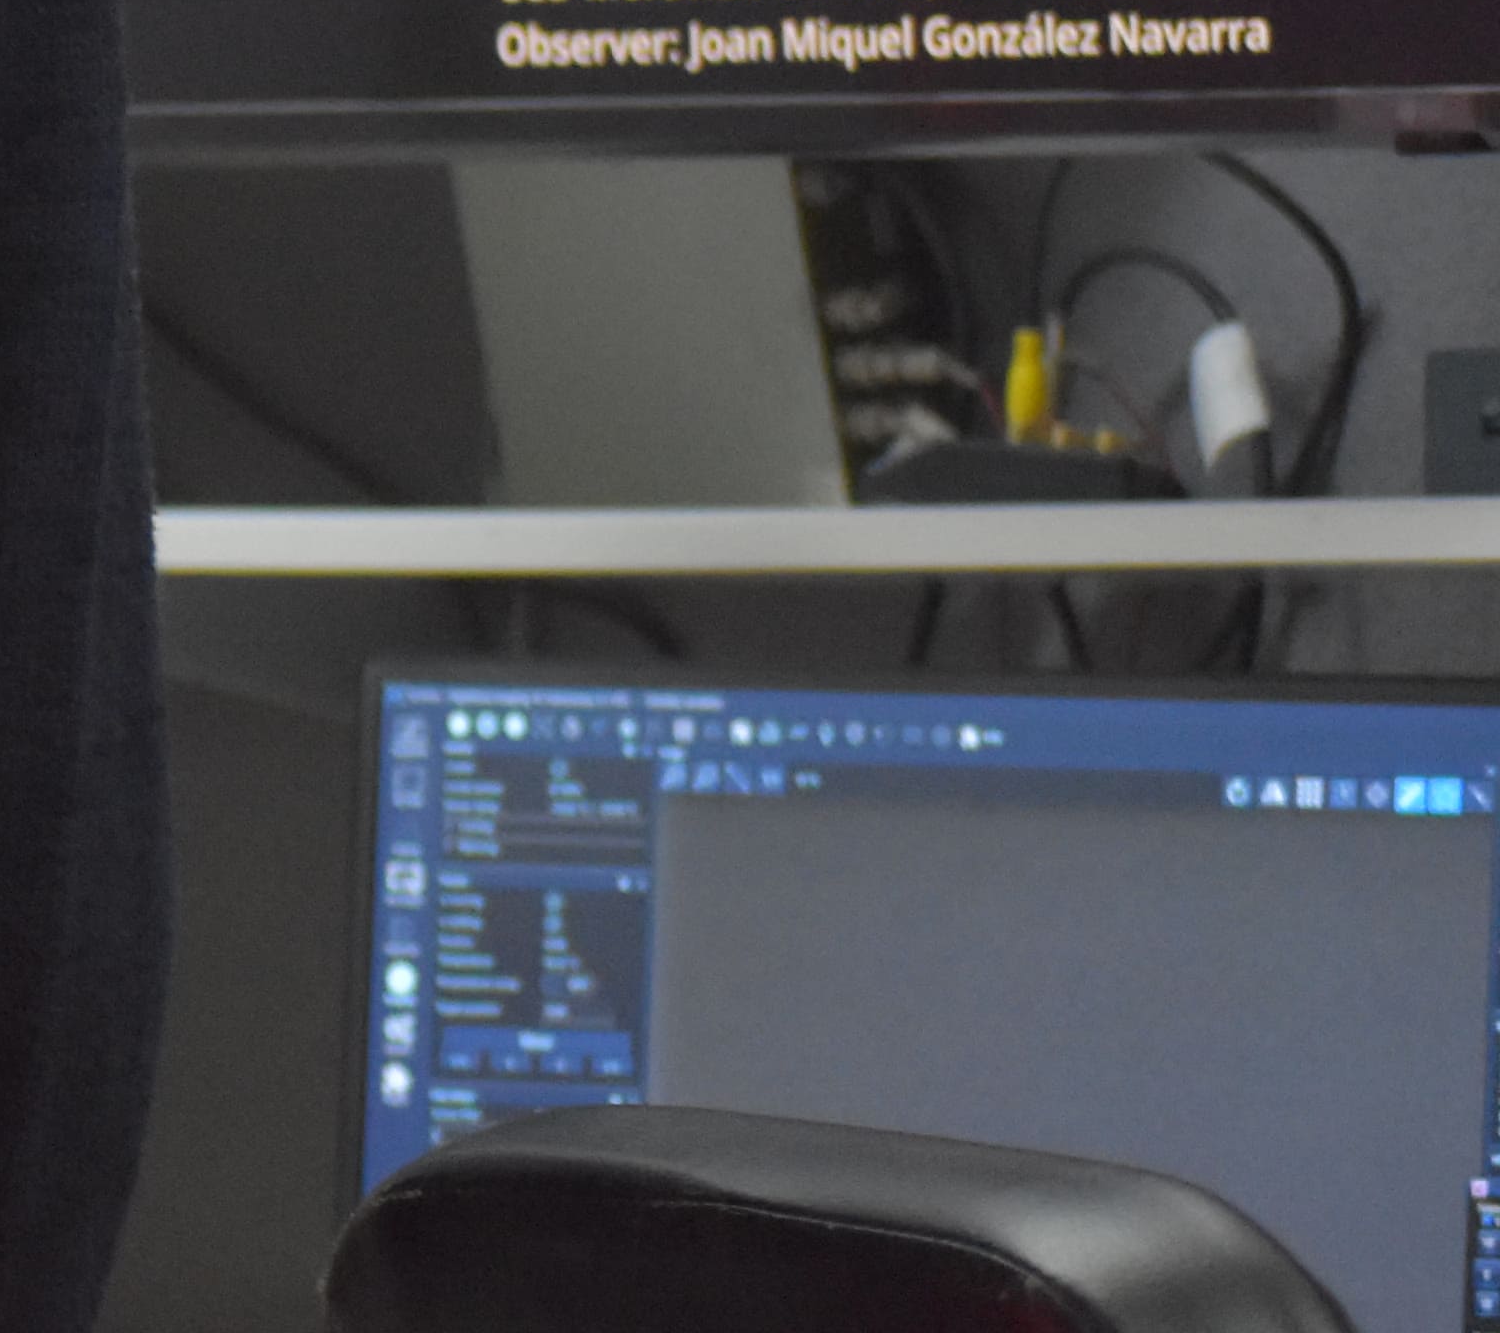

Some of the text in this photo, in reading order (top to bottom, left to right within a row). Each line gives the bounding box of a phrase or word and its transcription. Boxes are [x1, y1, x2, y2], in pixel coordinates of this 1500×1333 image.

[496, 9, 1272, 74] Observer: Joan Miquel González Navarra
